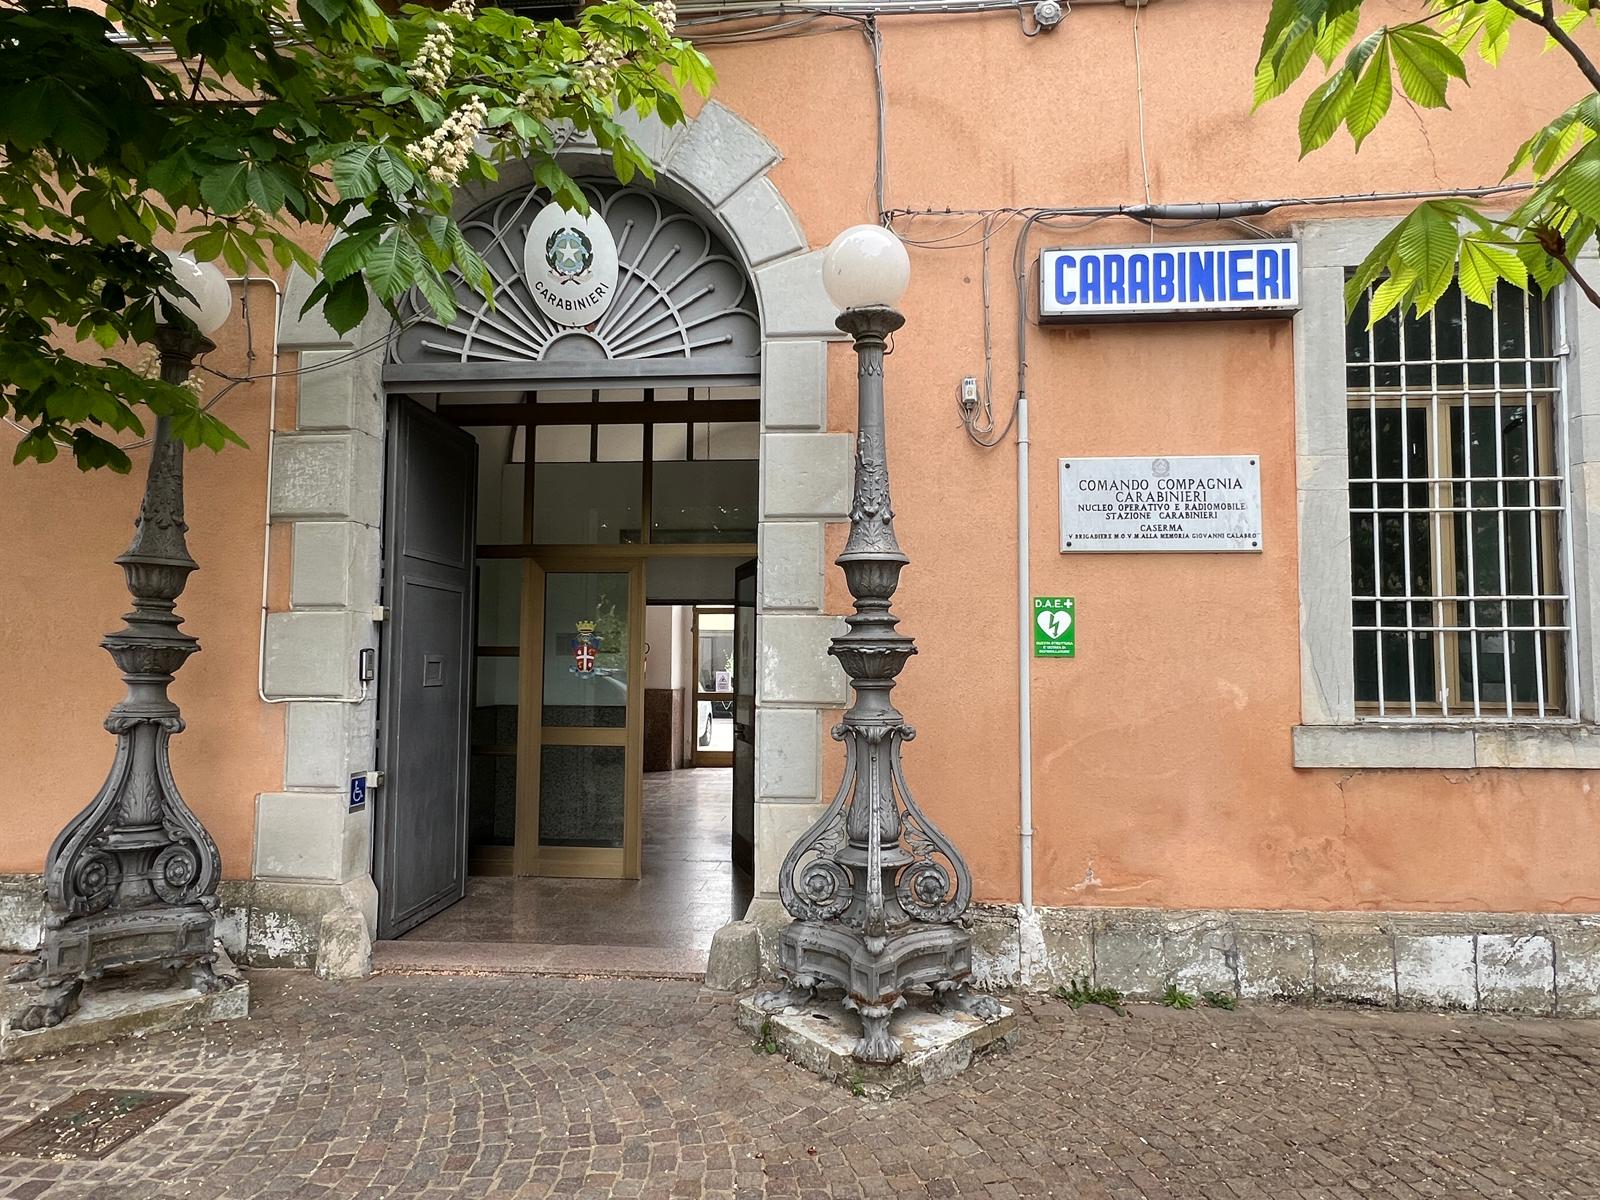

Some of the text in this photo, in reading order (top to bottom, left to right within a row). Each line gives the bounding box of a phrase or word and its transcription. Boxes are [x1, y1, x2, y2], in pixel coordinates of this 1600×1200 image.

[1055, 249, 1291, 305] CARABINIERI
[535, 281, 609, 311] CARABINIERI
[1079, 478, 1243, 491] COMANDO COMPAGNIA
[1115, 491, 1207, 502] CARABINIERI
[1078, 503, 1246, 512] NUCLEO OPERATIVO E RADIOMOBILE
[1105, 511, 1218, 520] STAZIONE CARABINIERI
[1140, 524, 1184, 532] CASERMA
